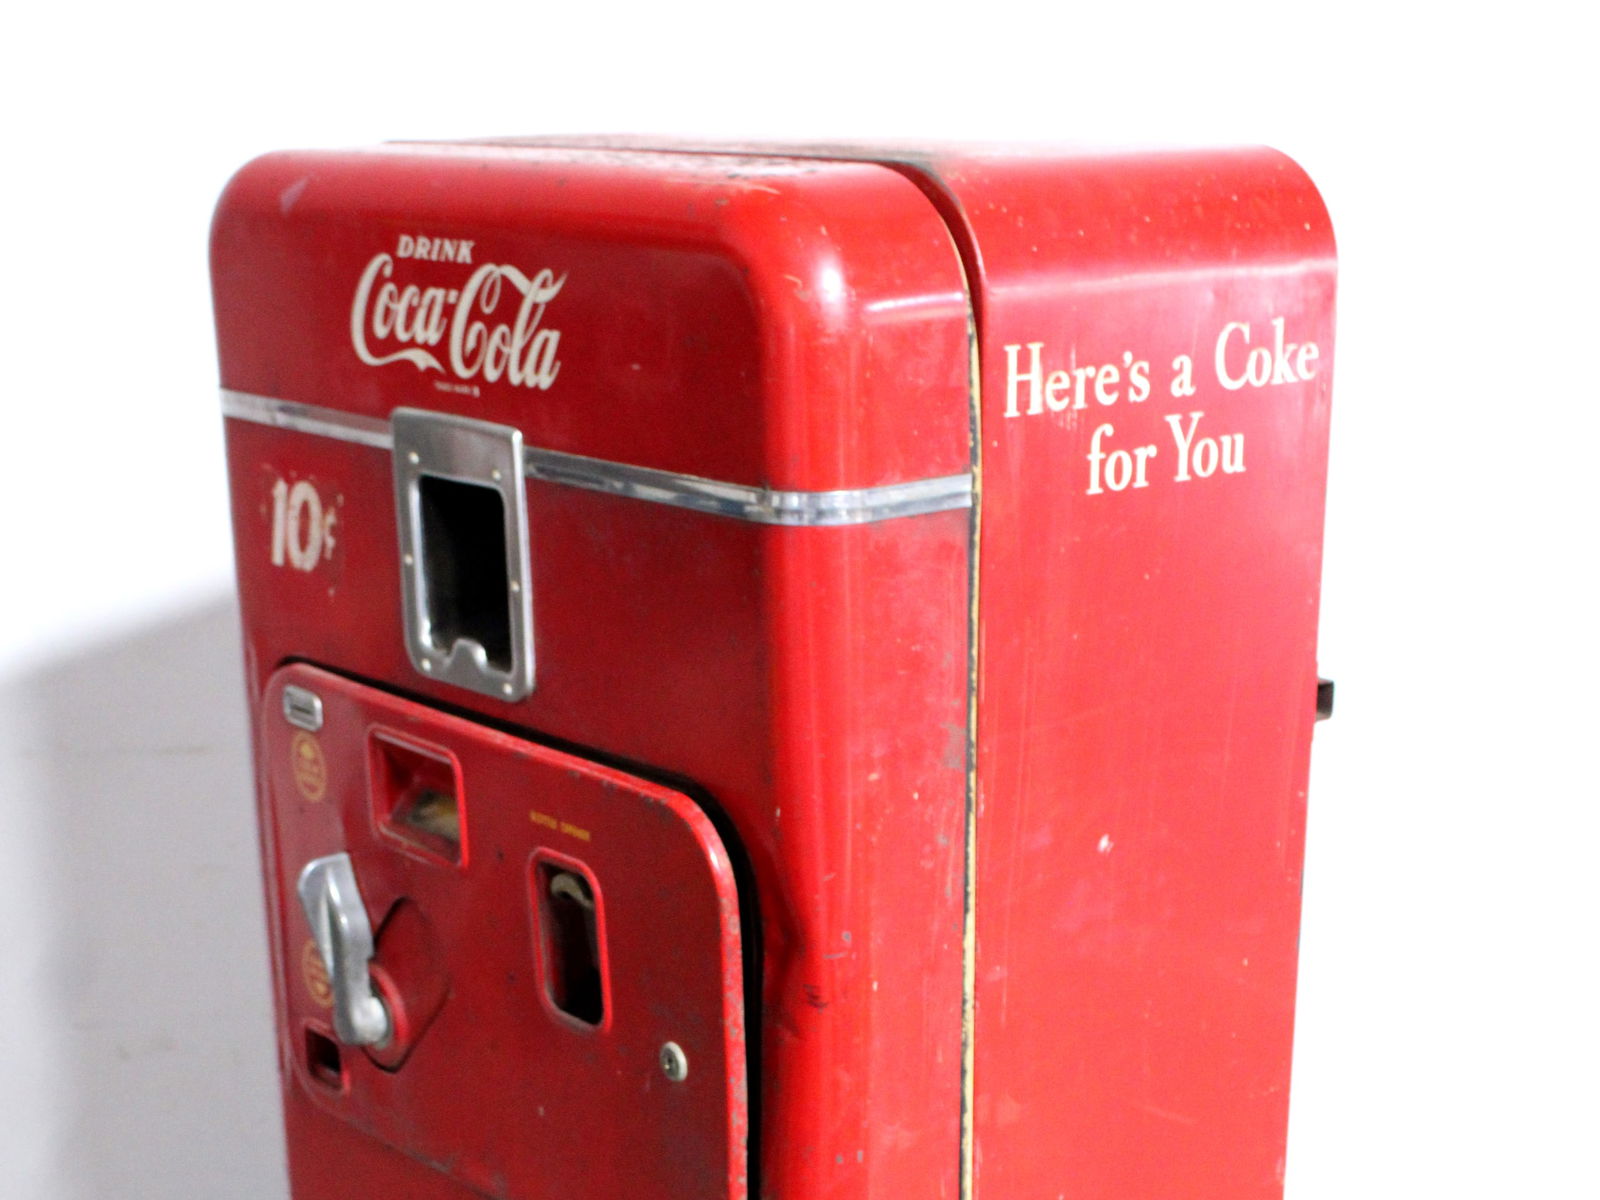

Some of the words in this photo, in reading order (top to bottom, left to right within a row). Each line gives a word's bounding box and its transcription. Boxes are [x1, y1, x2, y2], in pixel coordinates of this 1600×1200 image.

[396, 234, 476, 265] DRINK
[351, 252, 568, 391] Coca-Cola
[1003, 341, 1151, 418] Here's
[1170, 353, 1197, 398] a
[1214, 316, 1320, 391] Coke
[1085, 423, 1158, 495] for
[1164, 411, 1247, 482] You
